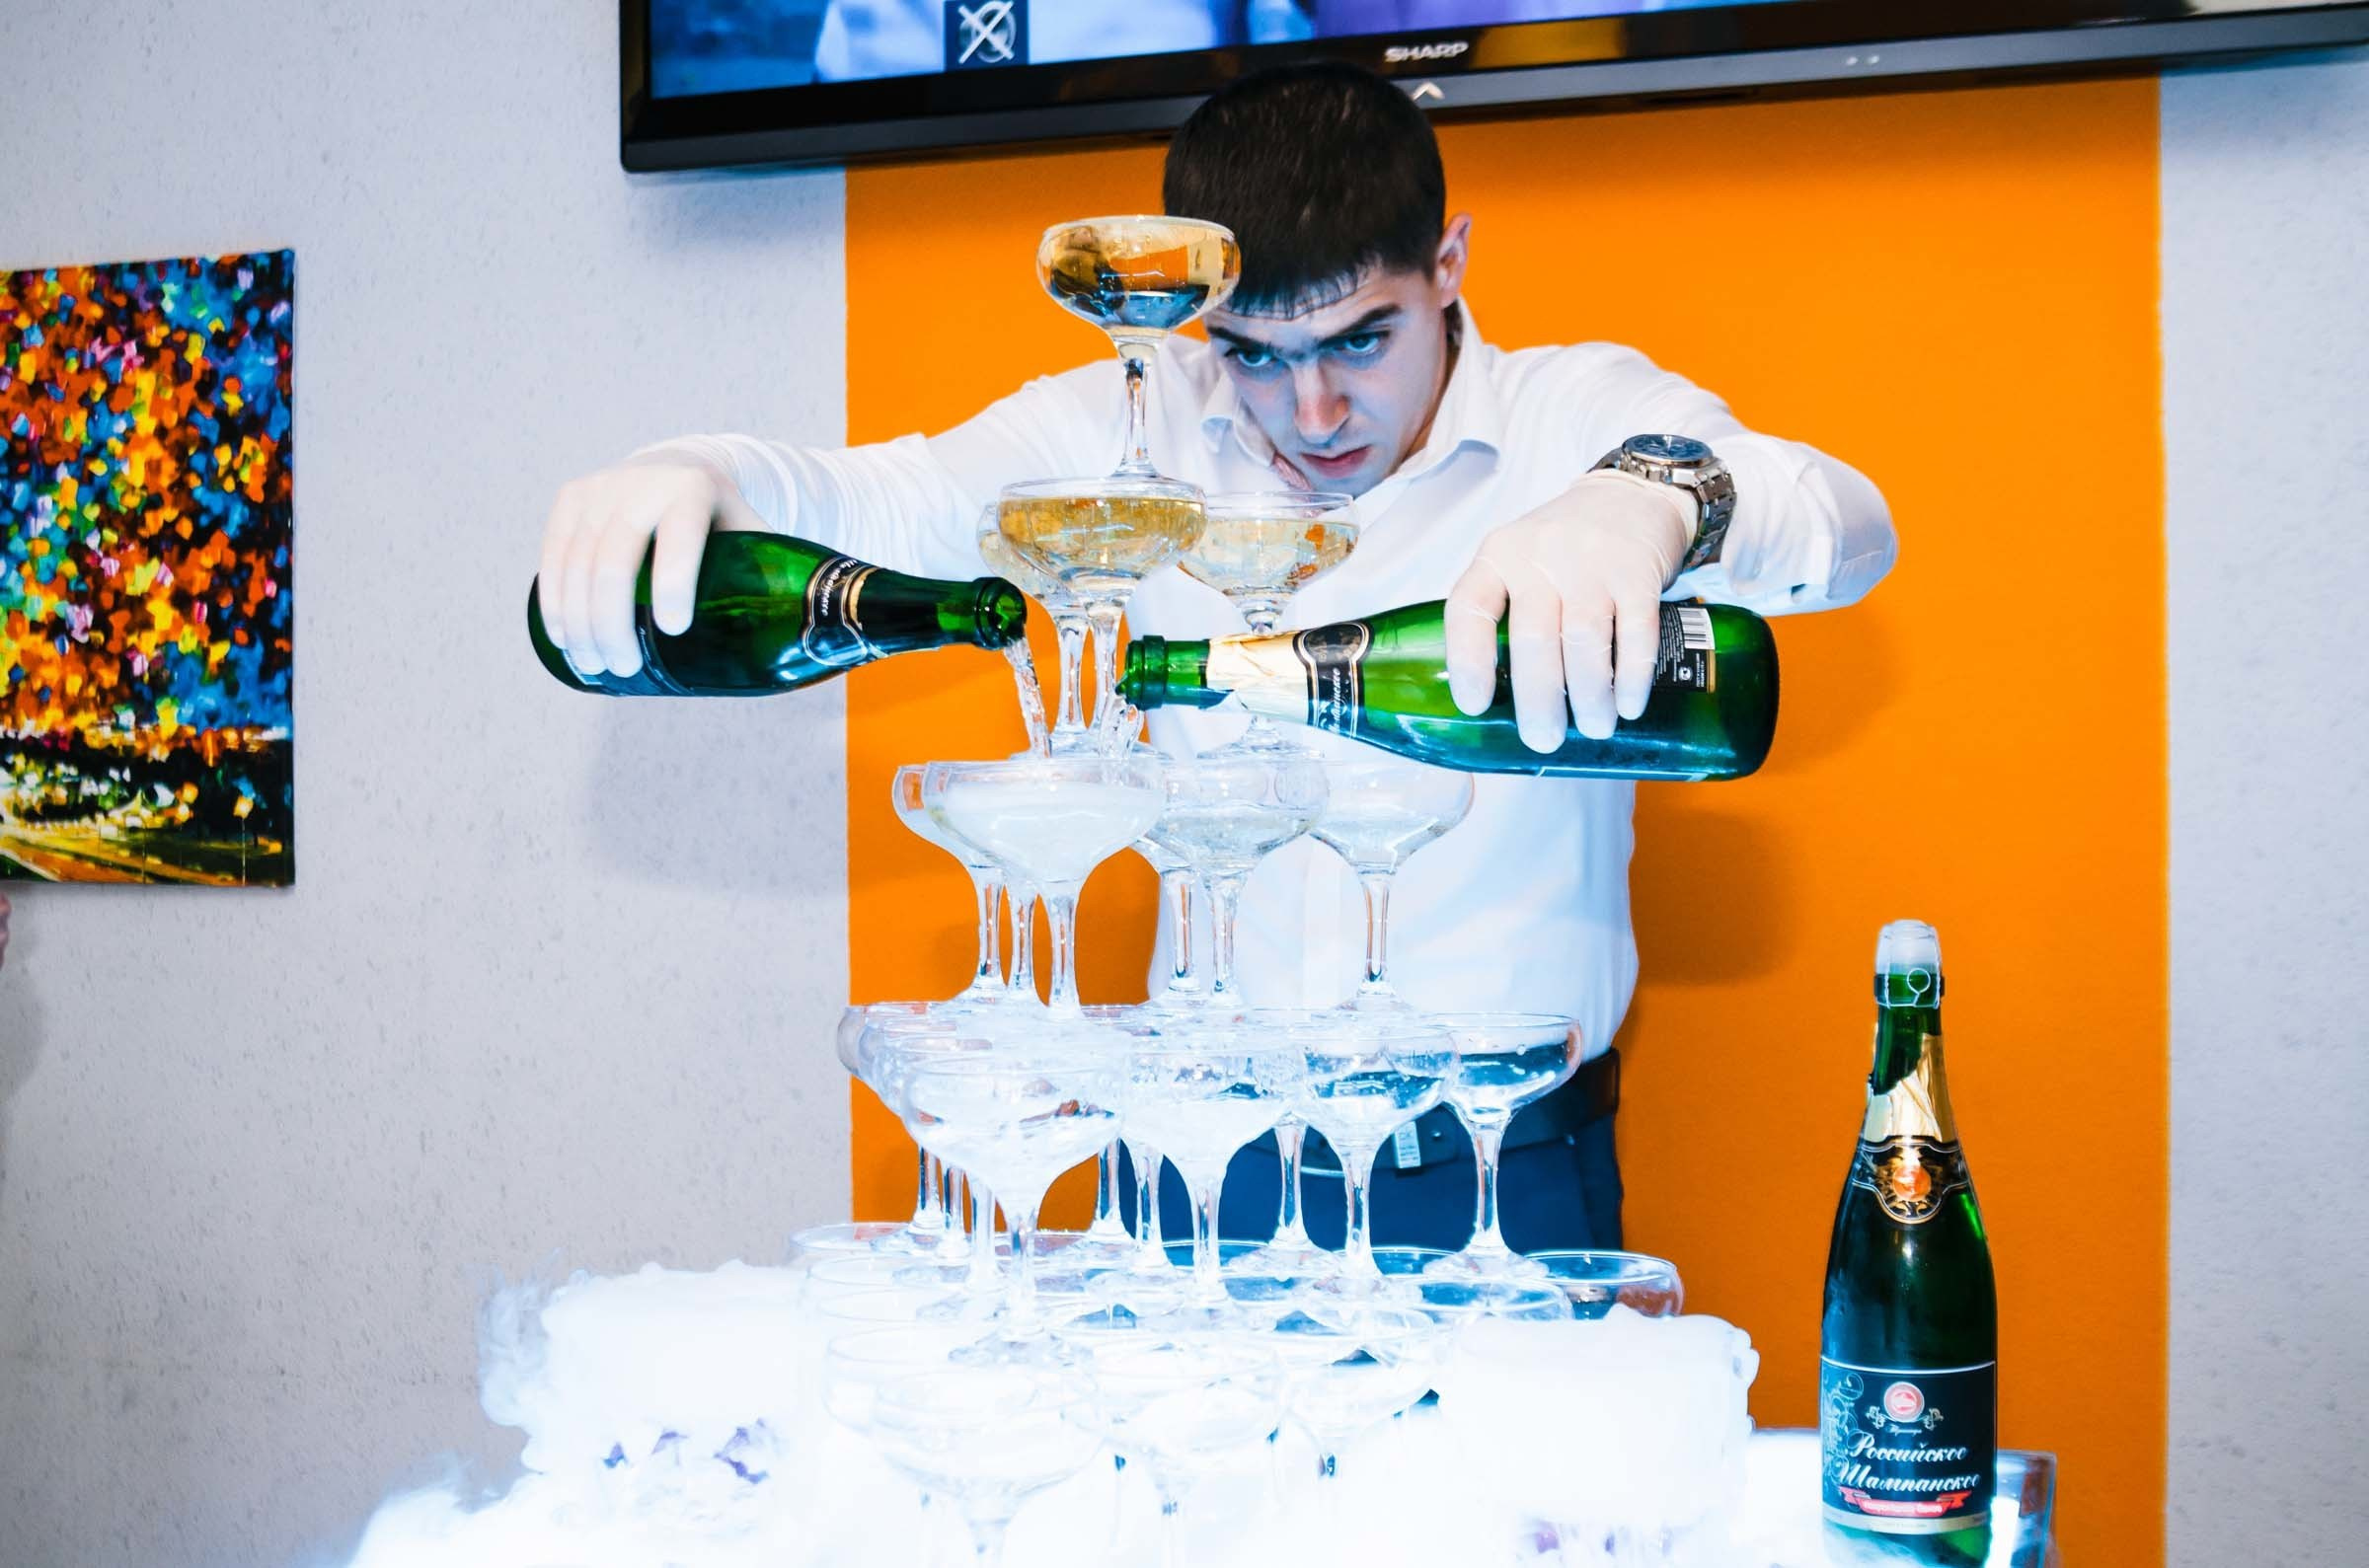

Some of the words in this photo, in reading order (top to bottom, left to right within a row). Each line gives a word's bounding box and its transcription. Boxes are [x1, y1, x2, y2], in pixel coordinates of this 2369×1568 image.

[1384, 41, 1469, 63] SHARP
[1848, 1429, 1967, 1461] Российское
[1836, 1461, 1981, 1492] Шампанское
